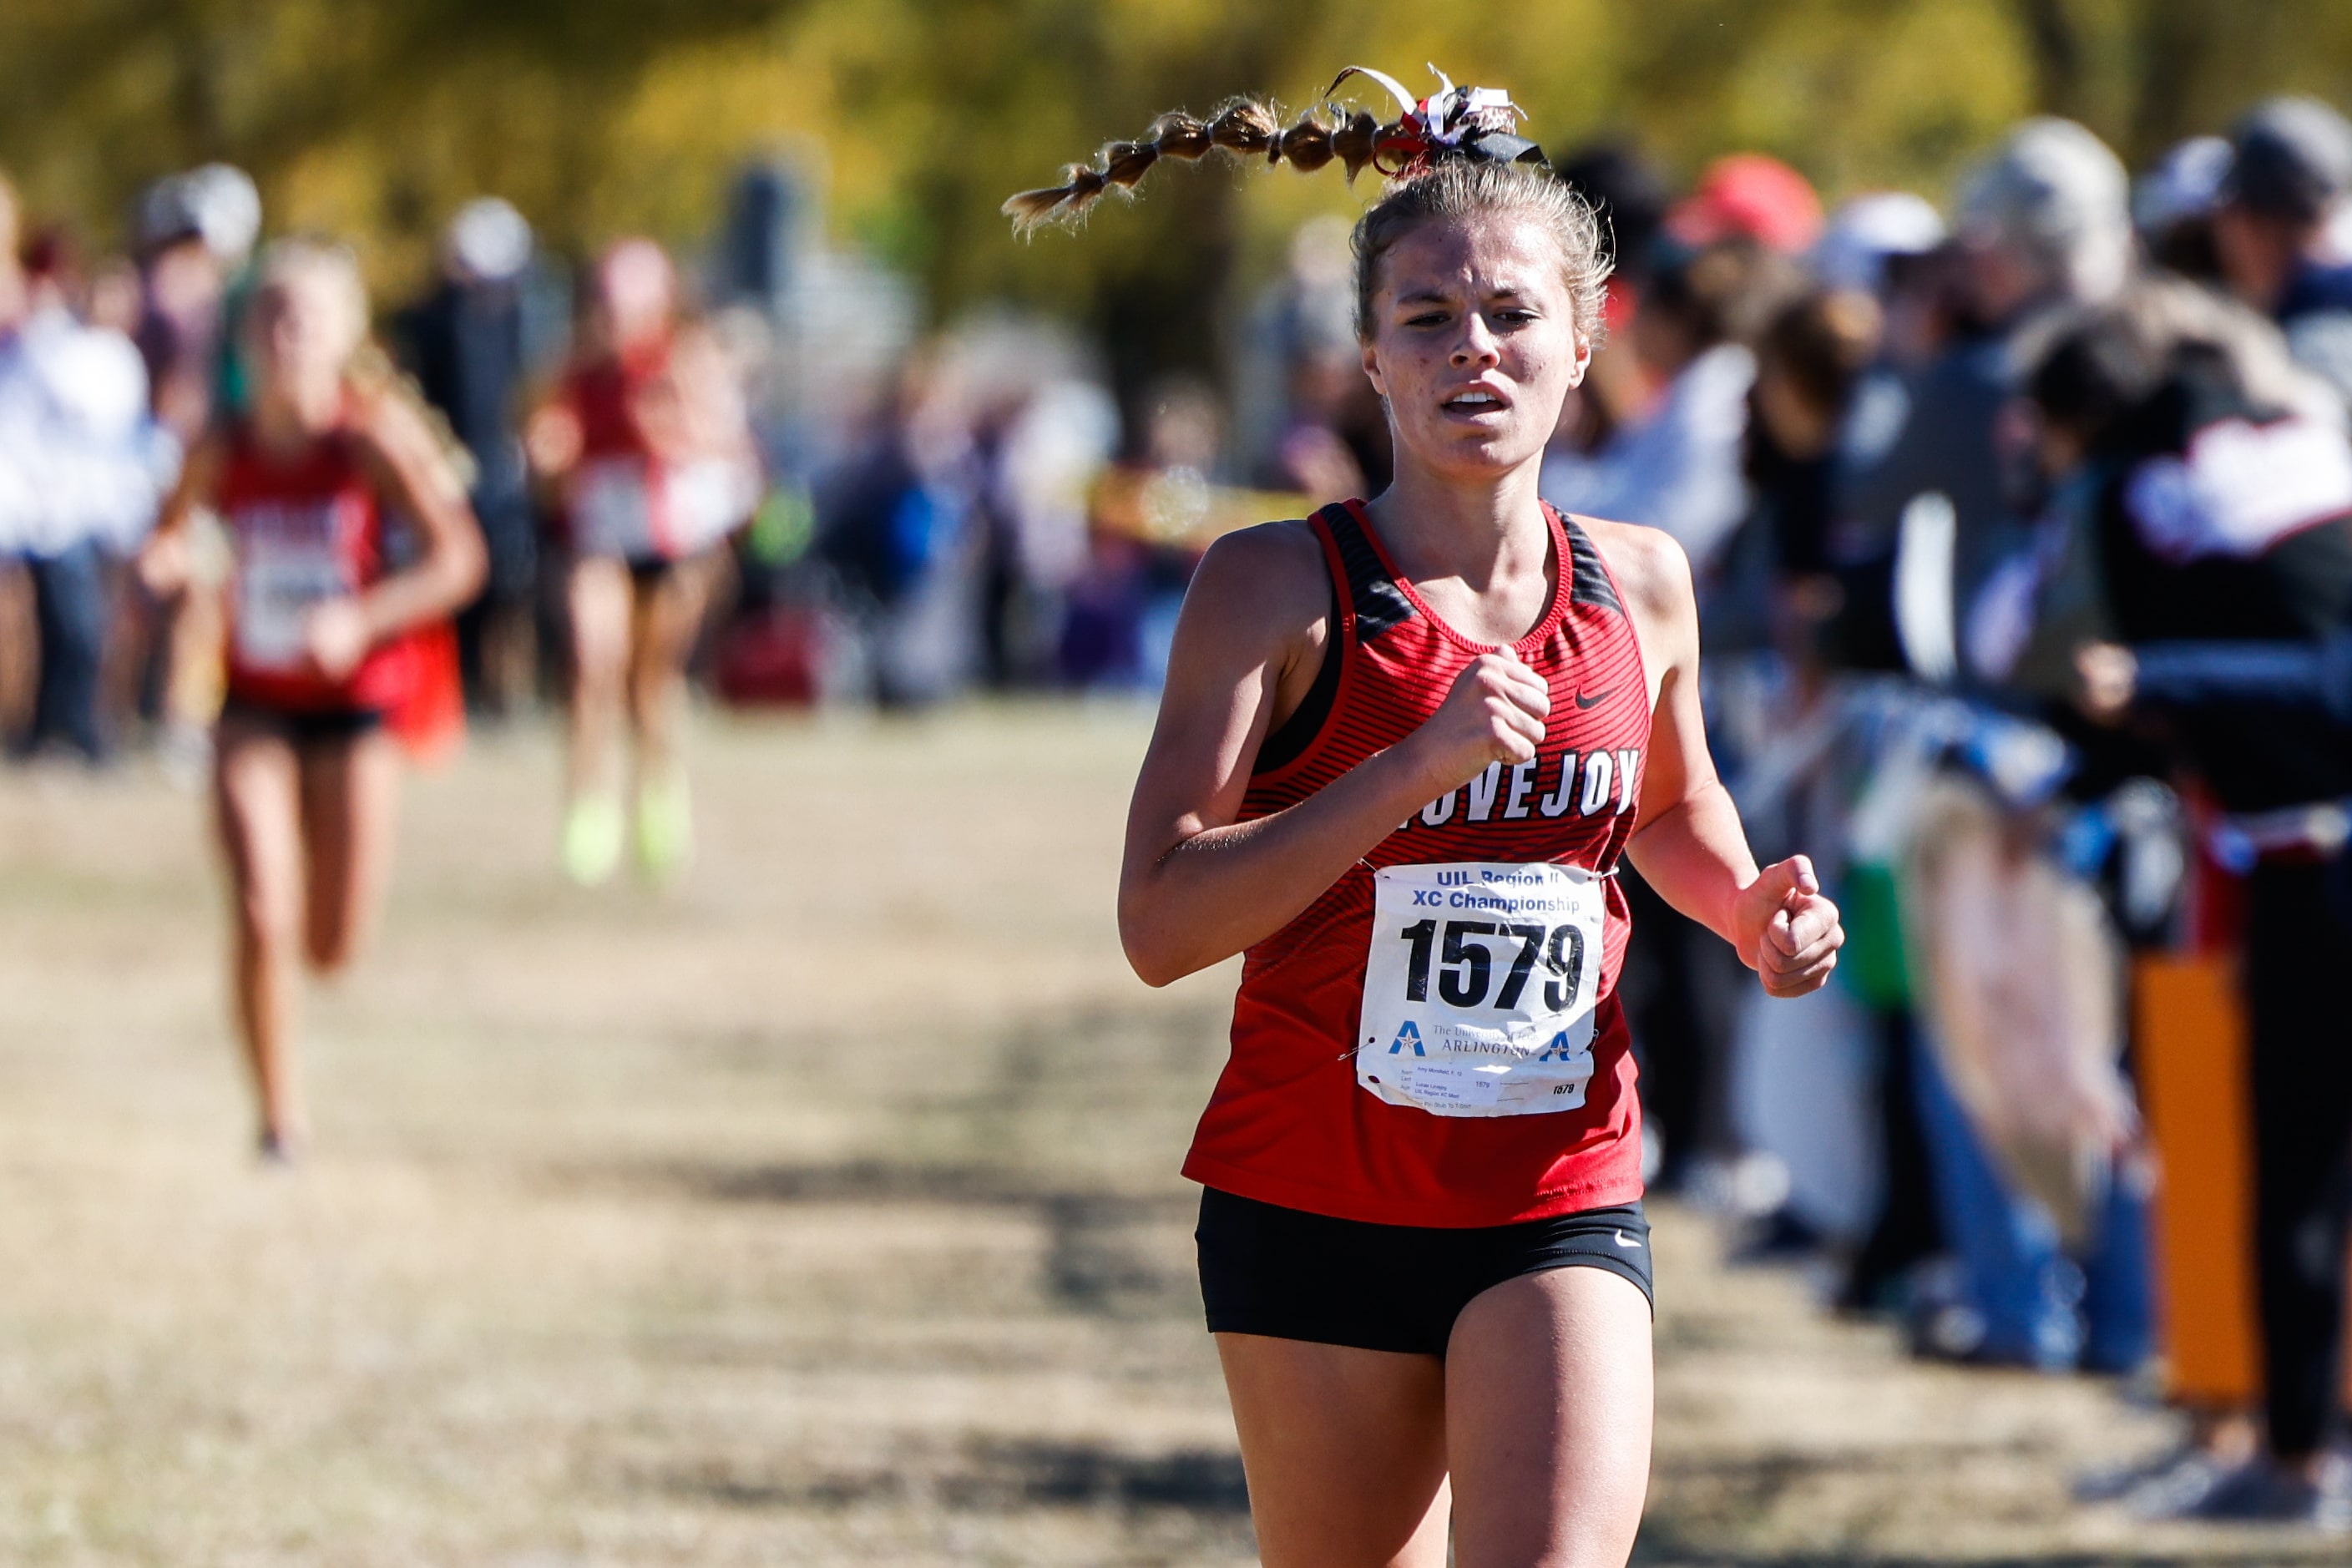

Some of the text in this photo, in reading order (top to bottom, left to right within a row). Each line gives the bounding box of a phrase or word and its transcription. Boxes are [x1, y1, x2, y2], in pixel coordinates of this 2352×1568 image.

[1398, 750, 1639, 829] OVEJOY
[1436, 871, 1474, 886] UIL
[1481, 870, 1545, 888] Region
[1412, 890, 1581, 914] XC Championship
[1401, 918, 1585, 1013] 1579
[1433, 1024, 1451, 1036] The
[1454, 1025, 1500, 1041] University
[1441, 1038, 1530, 1056] ARLINGTON
[1475, 1080, 1490, 1089] 1579
